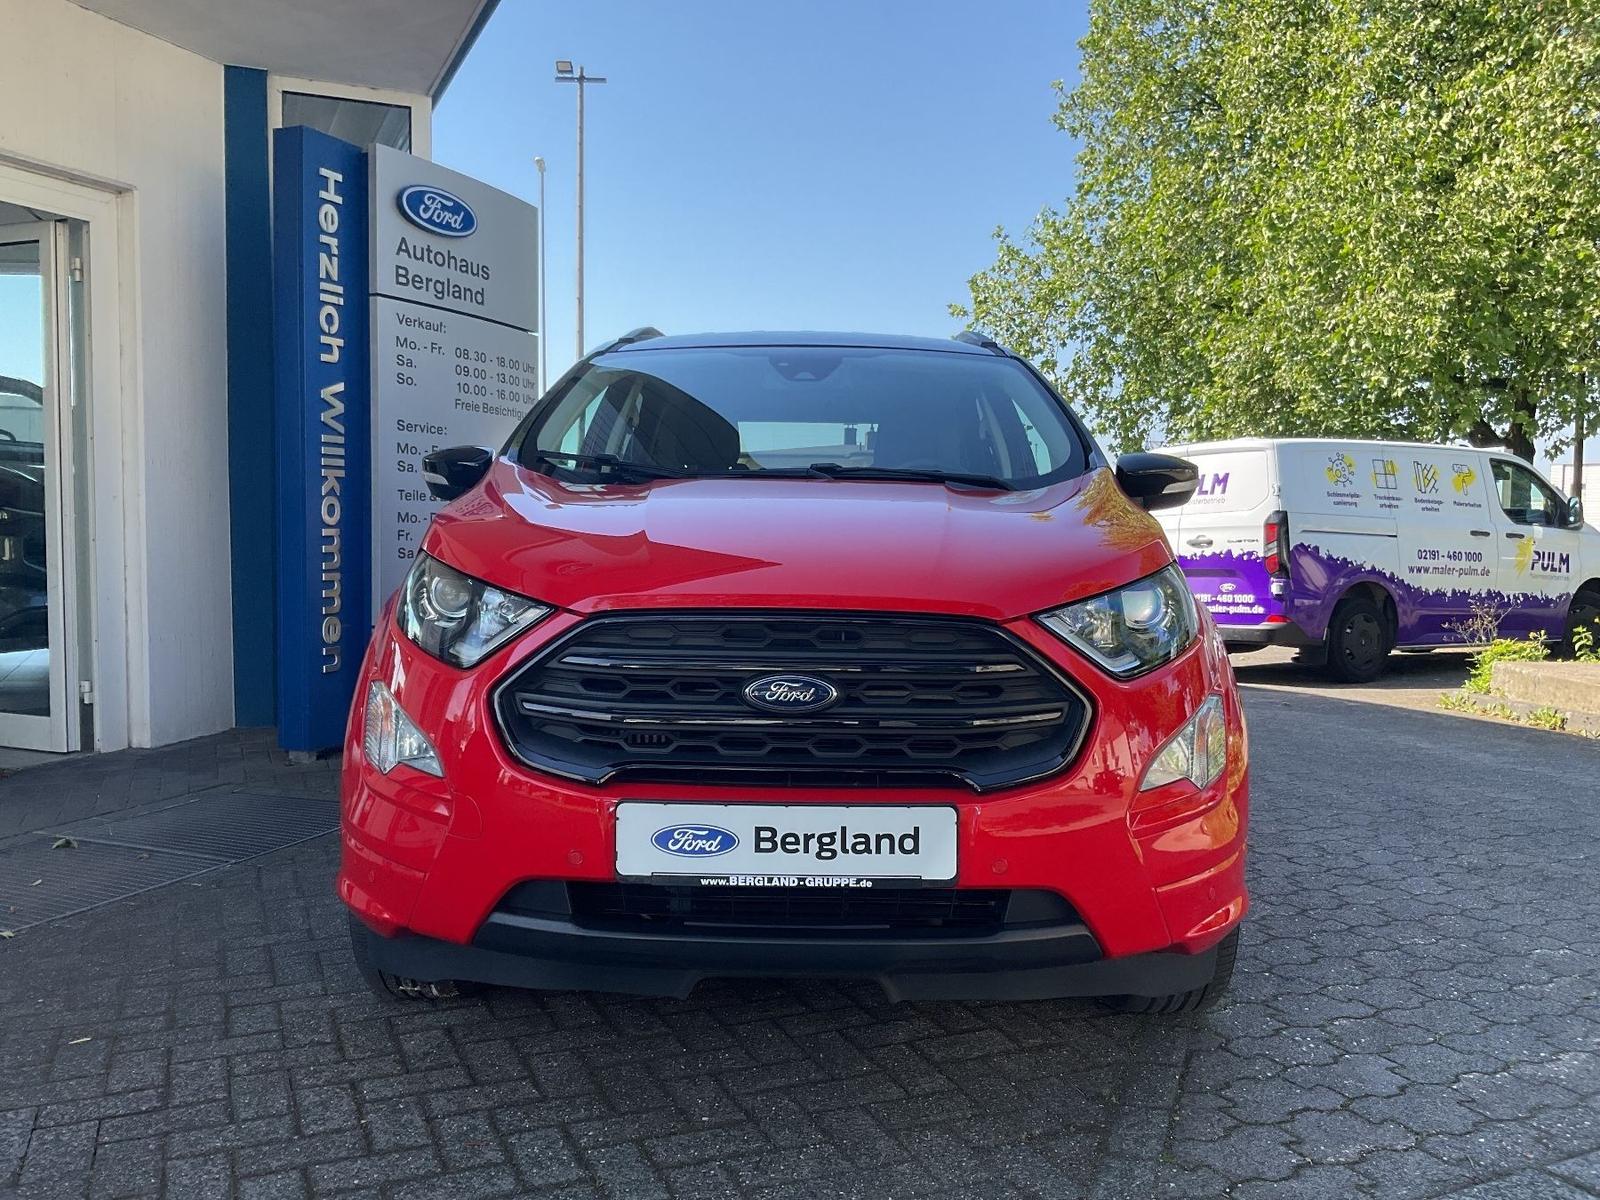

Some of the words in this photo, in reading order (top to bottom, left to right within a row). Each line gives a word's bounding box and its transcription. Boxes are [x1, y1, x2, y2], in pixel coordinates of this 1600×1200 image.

[419, 193, 464, 229] Ford
[319, 167, 344, 363] Herzlich
[395, 236, 490, 280] Autohaus
[395, 264, 485, 305] Bergland
[396, 312, 447, 333] Verkauf:
[395, 335, 420, 351] Mo.
[431, 341, 445, 355] Fr.
[455, 347, 487, 363] 08.30
[496, 356, 520, 371] 18.00
[522, 362, 535, 374] Uhr
[396, 354, 417, 368] Sa.
[455, 365, 487, 380] 09.00
[496, 373, 520, 387] 13.00
[522, 377, 535, 389] Uhr
[396, 372, 417, 386] So.
[456, 382, 487, 396] 10.00
[496, 389, 520, 402] 16.00
[455, 398, 481, 412] Freie
[482, 402, 527, 421] Besichtigu
[397, 419, 448, 435] Service:
[397, 442, 421, 455] Mo.
[397, 460, 417, 473] Sa.
[397, 489, 427, 502] Teile
[1197, 472, 1230, 496] LM
[320, 382, 345, 673] Willkommen
[397, 511, 421, 524] Mo.
[397, 529, 413, 541] Fr.
[1417, 549, 1440, 561] 02191
[1446, 550, 1463, 562] 460
[1464, 551, 1483, 563] 1000
[1531, 550, 1570, 573] PULM
[1408, 564, 1490, 577] www.maler-pulm.de
[765, 681, 815, 702] Ford
[668, 828, 720, 853] Ford
[753, 825, 920, 861] Bergland
